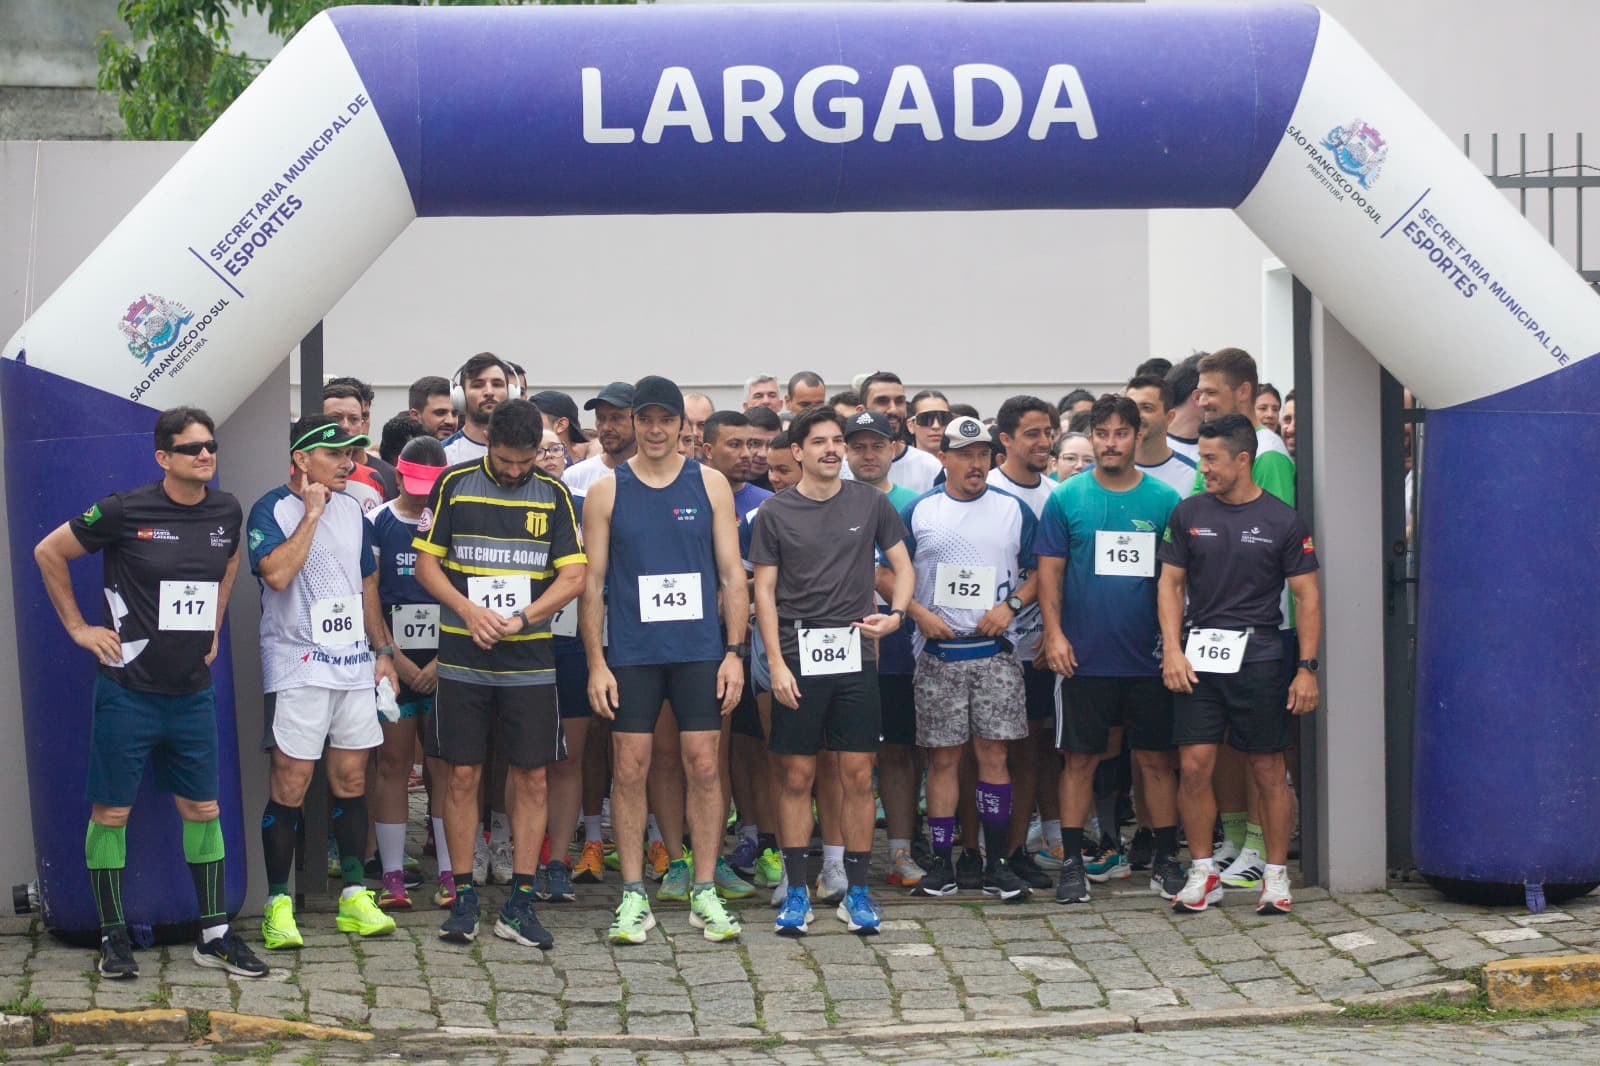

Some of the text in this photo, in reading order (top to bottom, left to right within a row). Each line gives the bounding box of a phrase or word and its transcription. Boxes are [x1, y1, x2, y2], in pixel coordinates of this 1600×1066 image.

[582, 63, 1098, 144] LARGADA
[210, 94, 369, 261] SECRETARIA MUNICIPAL DE
[1286, 125, 1383, 225] SÃO FRANCISCO DO SUL
[1306, 163, 1344, 202] PREFEITURA
[224, 194, 303, 276] ESPORTES
[1402, 221, 1478, 299] ESPORTES
[1418, 208, 1570, 366] SECRETARIA MUNICIPAL DE
[130, 298, 230, 402] SÃO FRANCISCO DO SUL
[168, 337, 208, 378] PREFEITURA
[474, 546, 511, 564] CHUTE
[1106, 548, 1140, 563] 163
[948, 582, 980, 596] 152
[172, 600, 205, 616] 117
[481, 593, 516, 608] 115
[651, 592, 688, 608] 143
[322, 616, 352, 633] 086
[404, 624, 436, 638] 071
[812, 648, 846, 662] 084
[1198, 645, 1230, 660] 166
